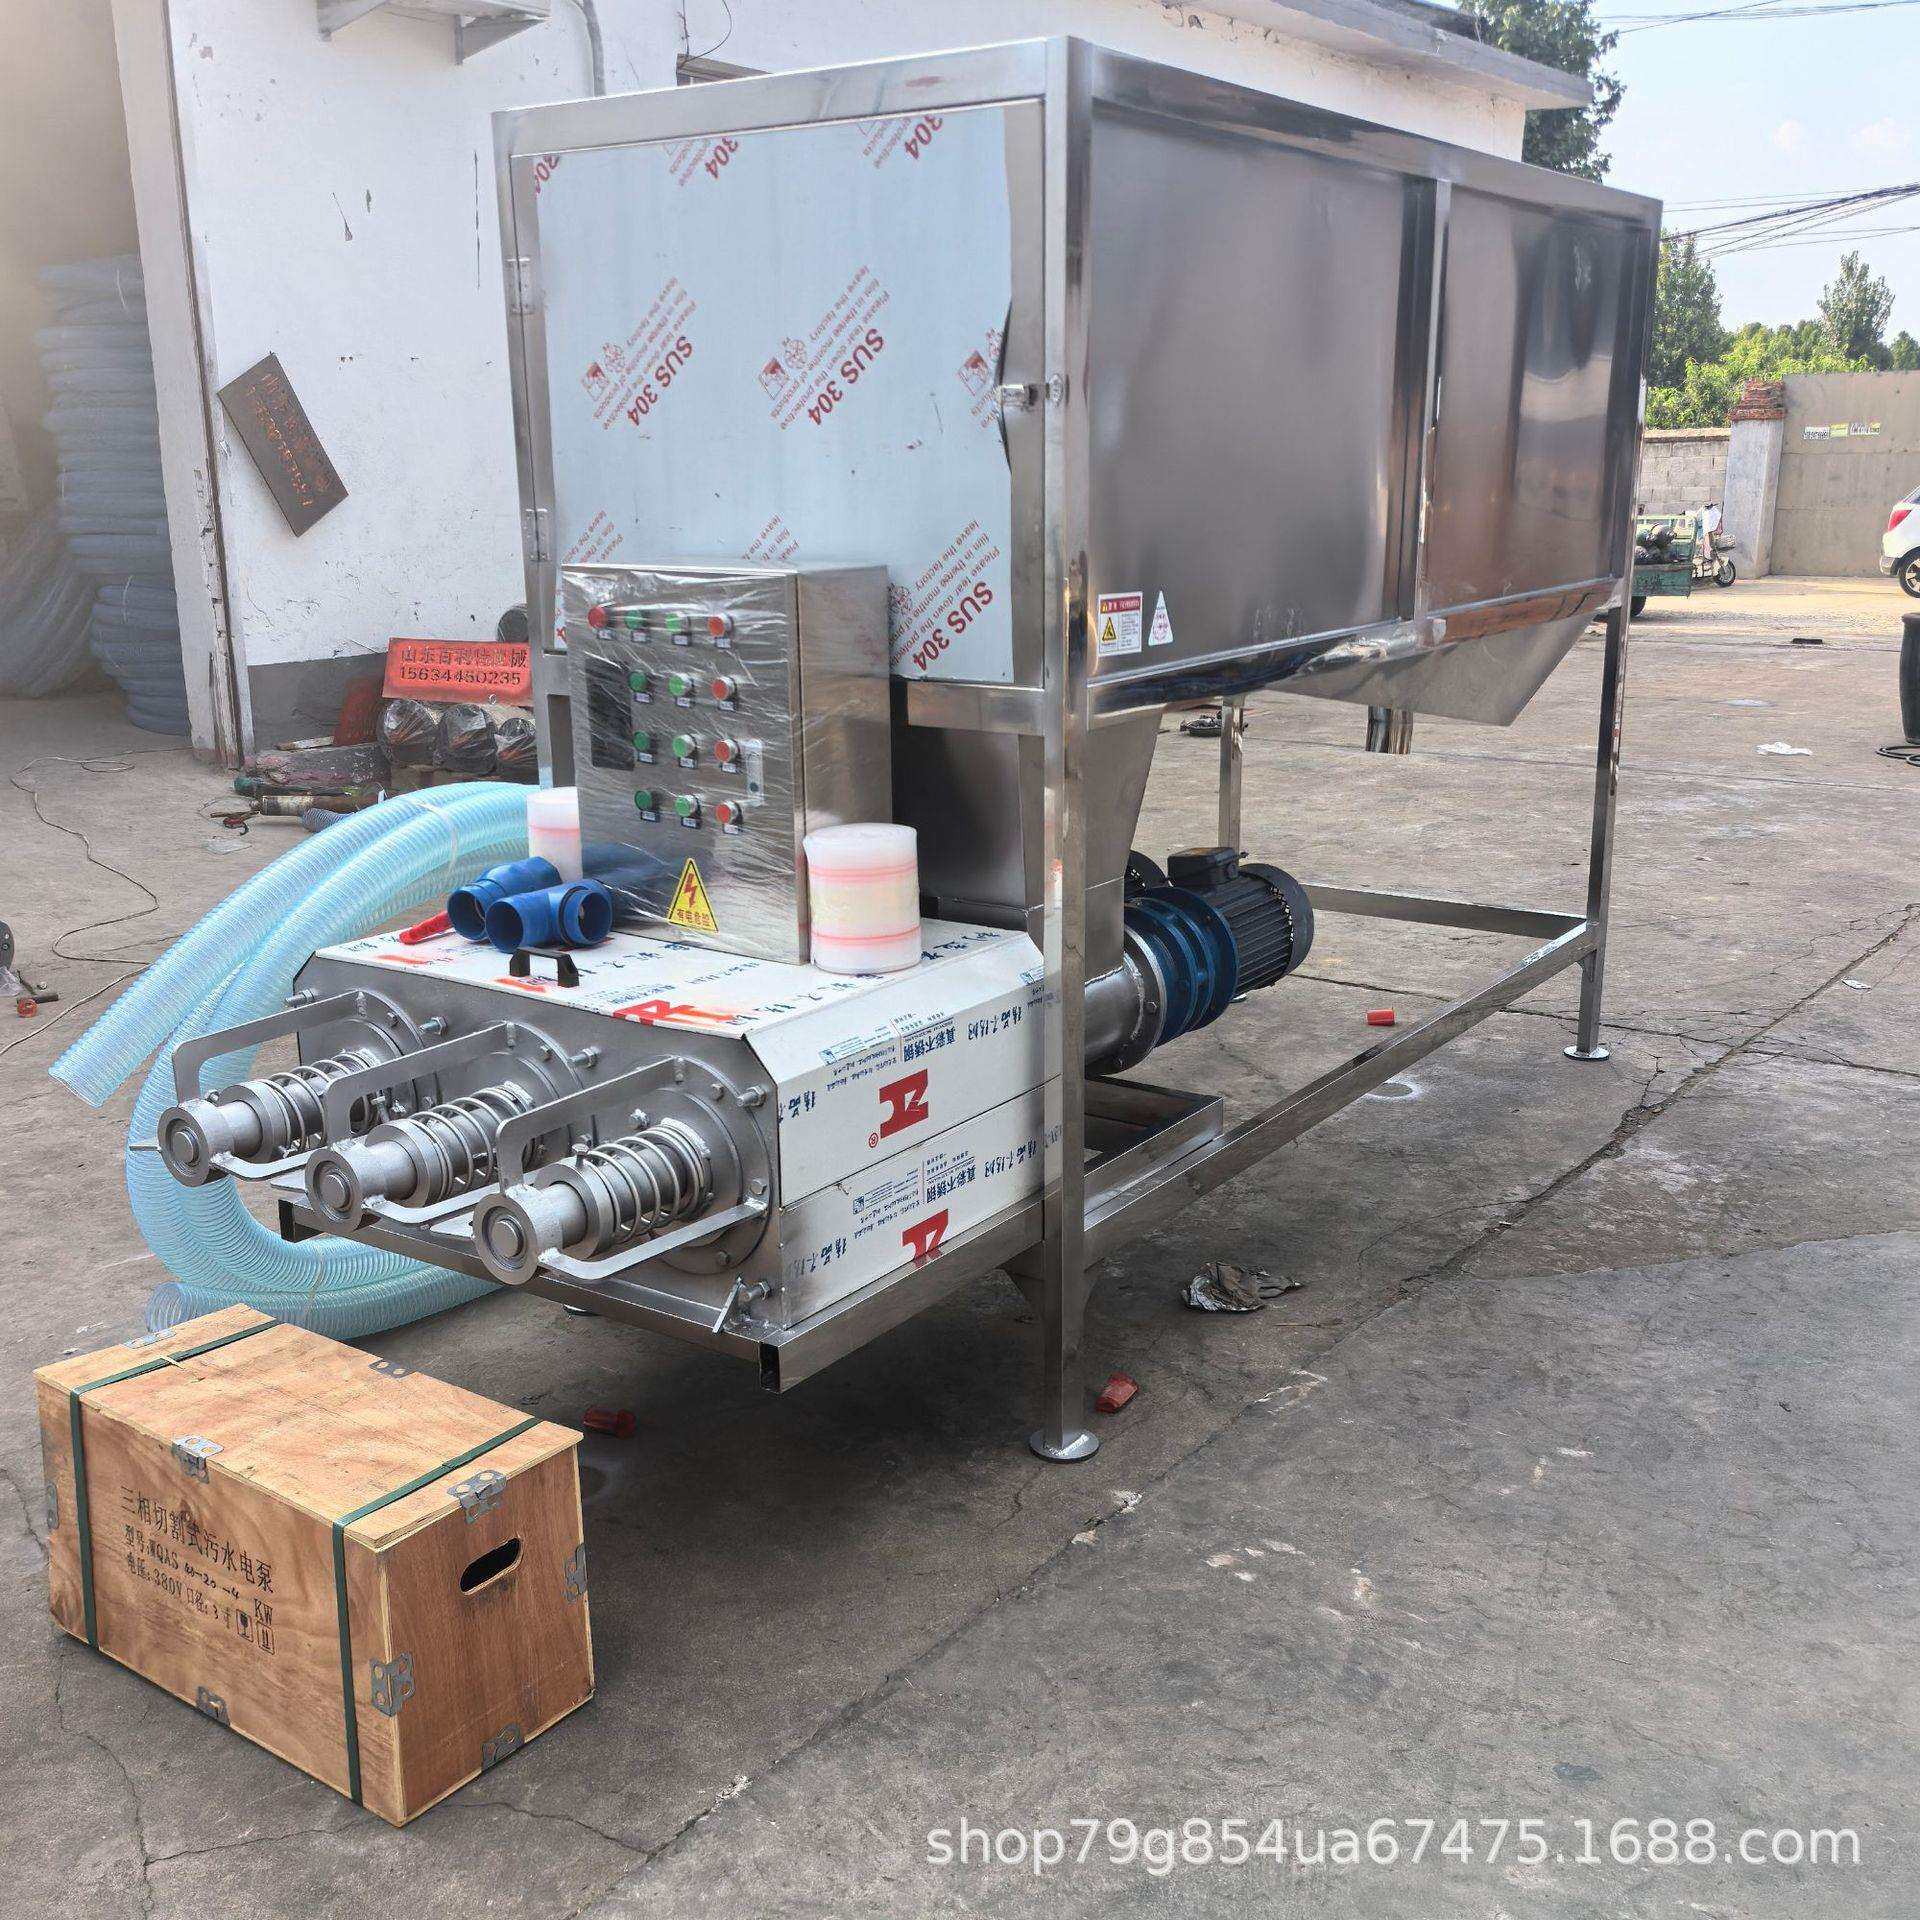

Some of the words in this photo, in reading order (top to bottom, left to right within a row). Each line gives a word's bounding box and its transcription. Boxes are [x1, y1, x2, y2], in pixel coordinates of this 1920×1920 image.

[654, 334, 694, 388] SUS
[838, 326, 885, 386] SUS
[626, 382, 658, 426] 304
[806, 379, 843, 426] 304
[946, 580, 993, 635] SUS
[911, 627, 950, 671] 304
